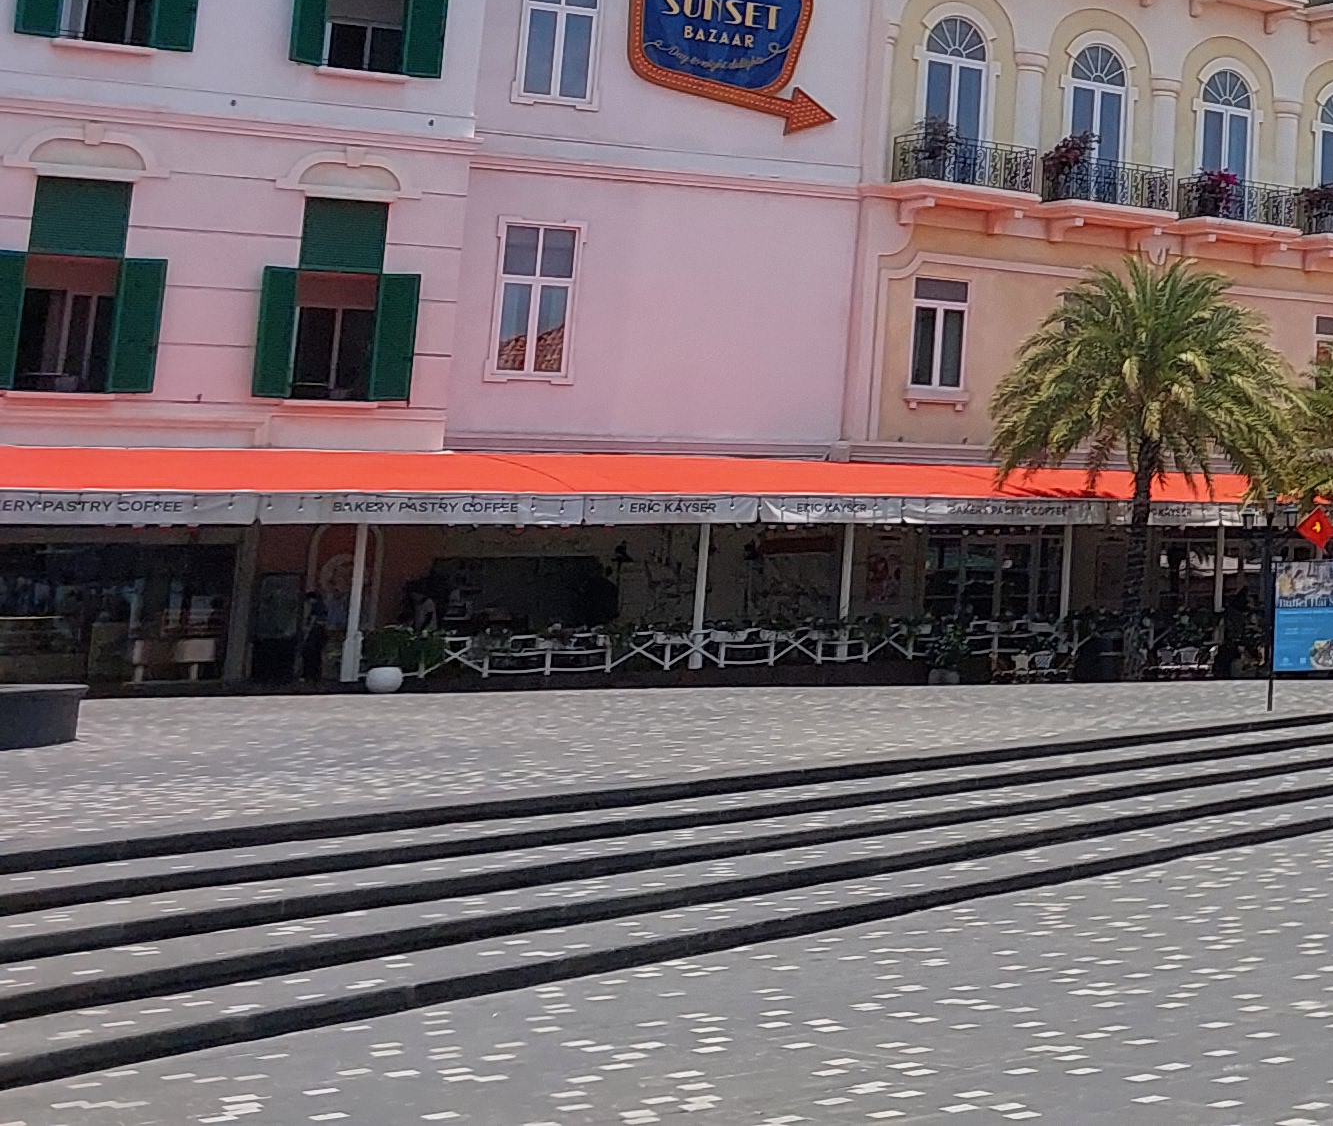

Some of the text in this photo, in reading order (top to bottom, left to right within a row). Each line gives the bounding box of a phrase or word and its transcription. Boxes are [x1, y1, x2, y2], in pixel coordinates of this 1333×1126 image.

[683, 25, 755, 48] BAZAAR
[0, 500, 184, 513] ERY PASTRY COFFEE
[332, 501, 519, 514] BAKERY PASTRY COFFEE
[629, 502, 717, 514] ERIC KAYSER
